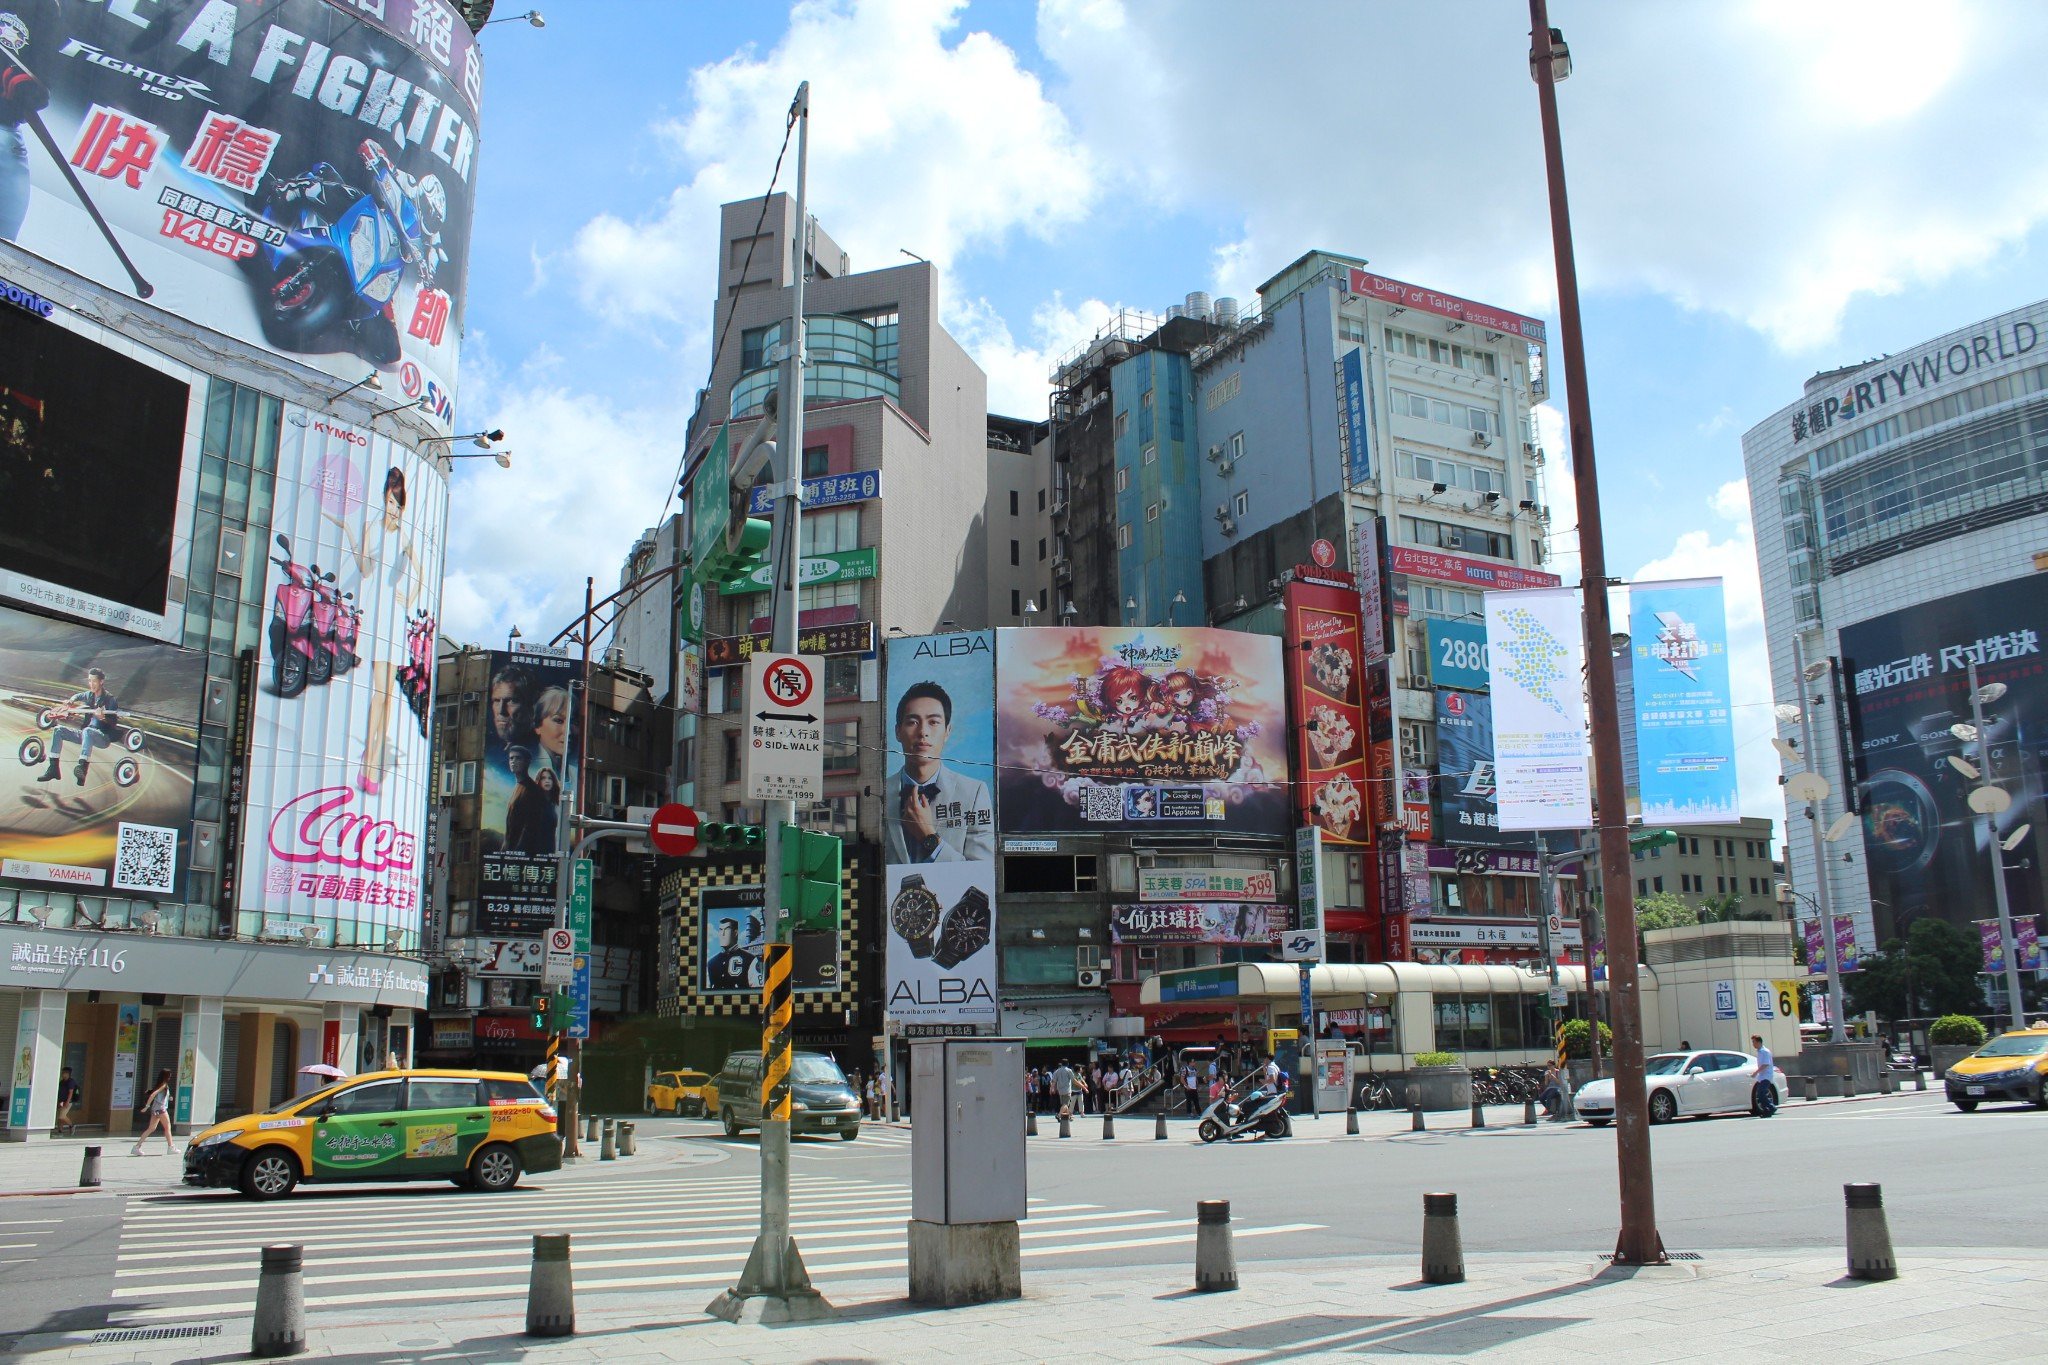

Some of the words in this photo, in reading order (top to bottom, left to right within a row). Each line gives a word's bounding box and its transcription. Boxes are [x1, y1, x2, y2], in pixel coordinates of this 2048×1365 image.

[141, 83, 184, 101] 150
[251, 24, 477, 184] FIGHTER
[71, 109, 154, 190] 快
[189, 116, 273, 189] 穩
[1373, 277, 1407, 296] Diary
[1411, 292, 1424, 306] of
[406, 288, 450, 347] 帥
[314, 421, 367, 447] KYMCO
[1466, 567, 1495, 582] HOTEL
[913, 635, 990, 660] ALBA
[1855, 652, 1934, 695] 感光元件
[1938, 628, 2040, 673] 尺寸先決
[773, 669, 802, 697] 停
[1862, 734, 1900, 750] SONY
[794, 791, 814, 799] 1999
[1172, 793, 1190, 802] Google
[1191, 794, 1202, 803] play
[936, 801, 961, 819] 自信
[48, 867, 92, 882] YAMAHA
[1184, 878, 1207, 890] SPA
[487, 903, 511, 913] 8.29
[11, 942, 128, 974] 誠品生活116
[337, 965, 395, 990] 誠品生活
[889, 978, 994, 1006] ALBA
[1778, 990, 1792, 1017] 6
